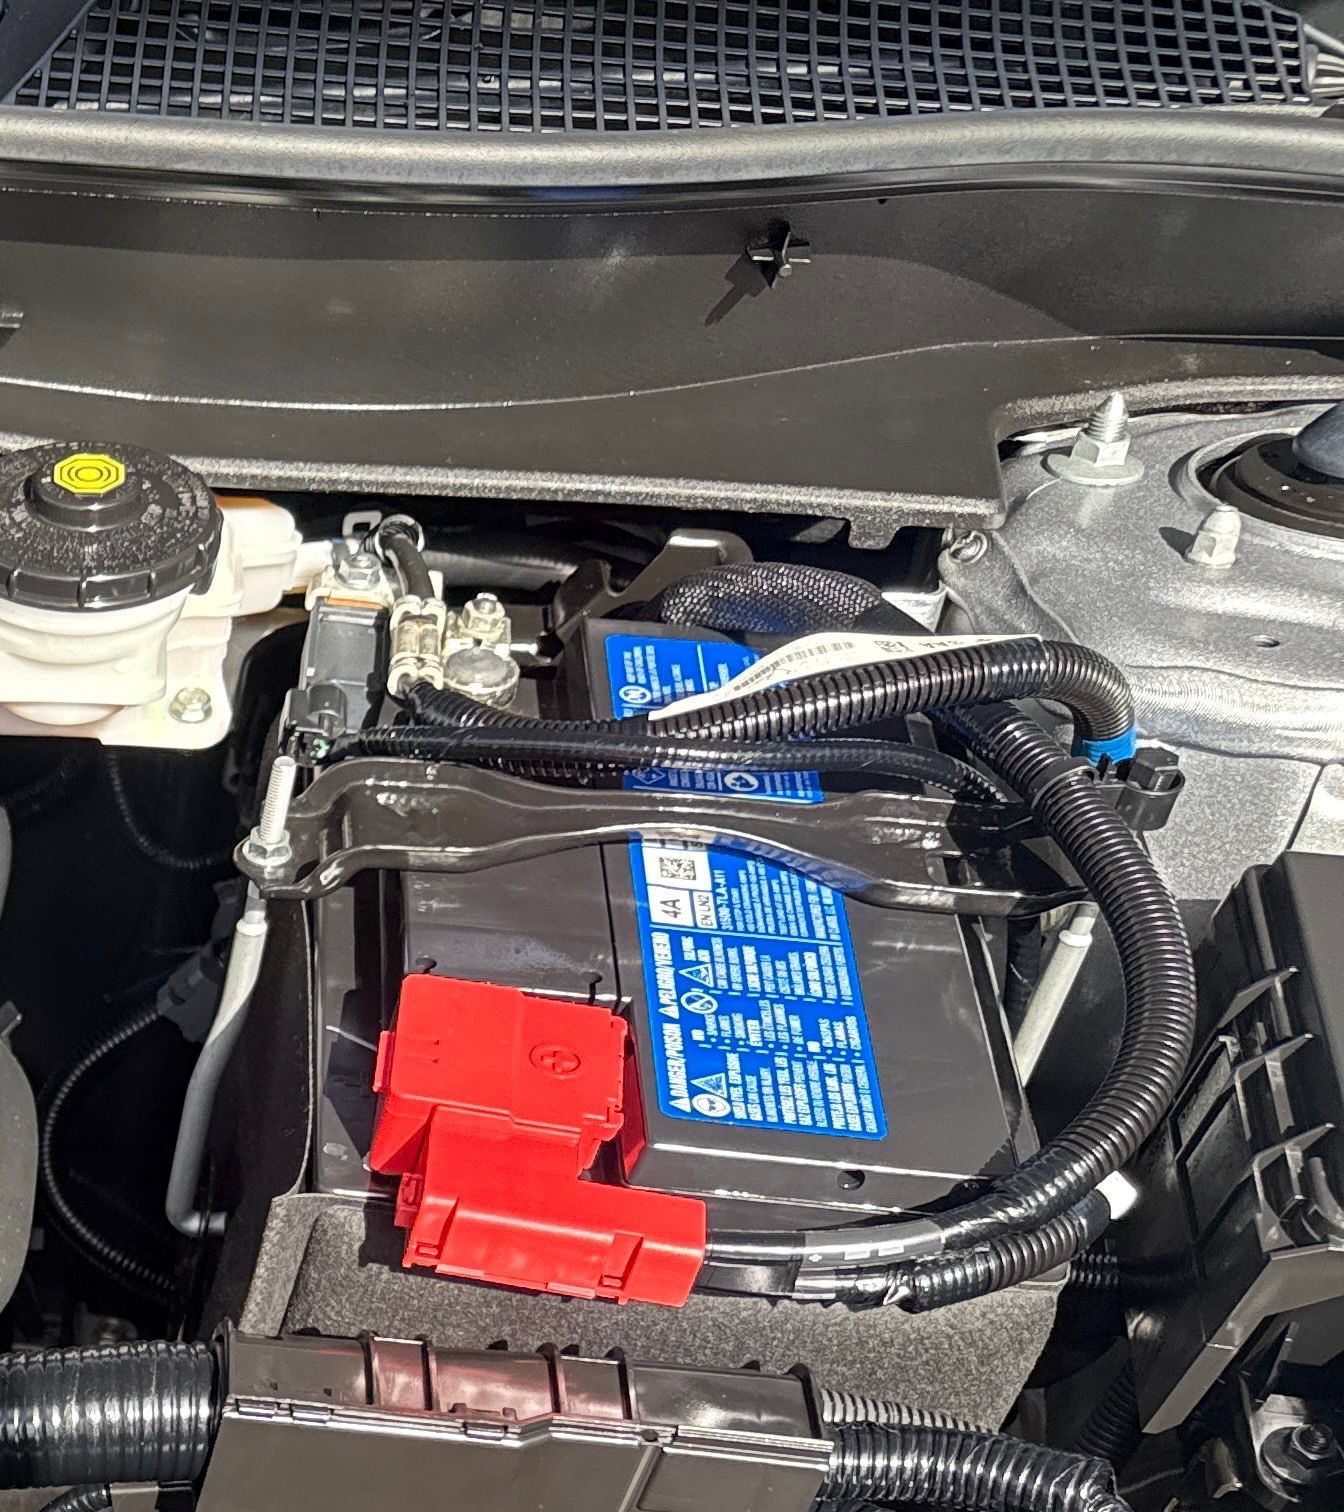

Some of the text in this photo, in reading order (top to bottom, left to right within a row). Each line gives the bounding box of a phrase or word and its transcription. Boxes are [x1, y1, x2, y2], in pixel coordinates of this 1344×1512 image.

[659, 898, 682, 918] 4A
[696, 894, 713, 926] EN LN2
[661, 1022, 690, 1098] DANGER/POISON
